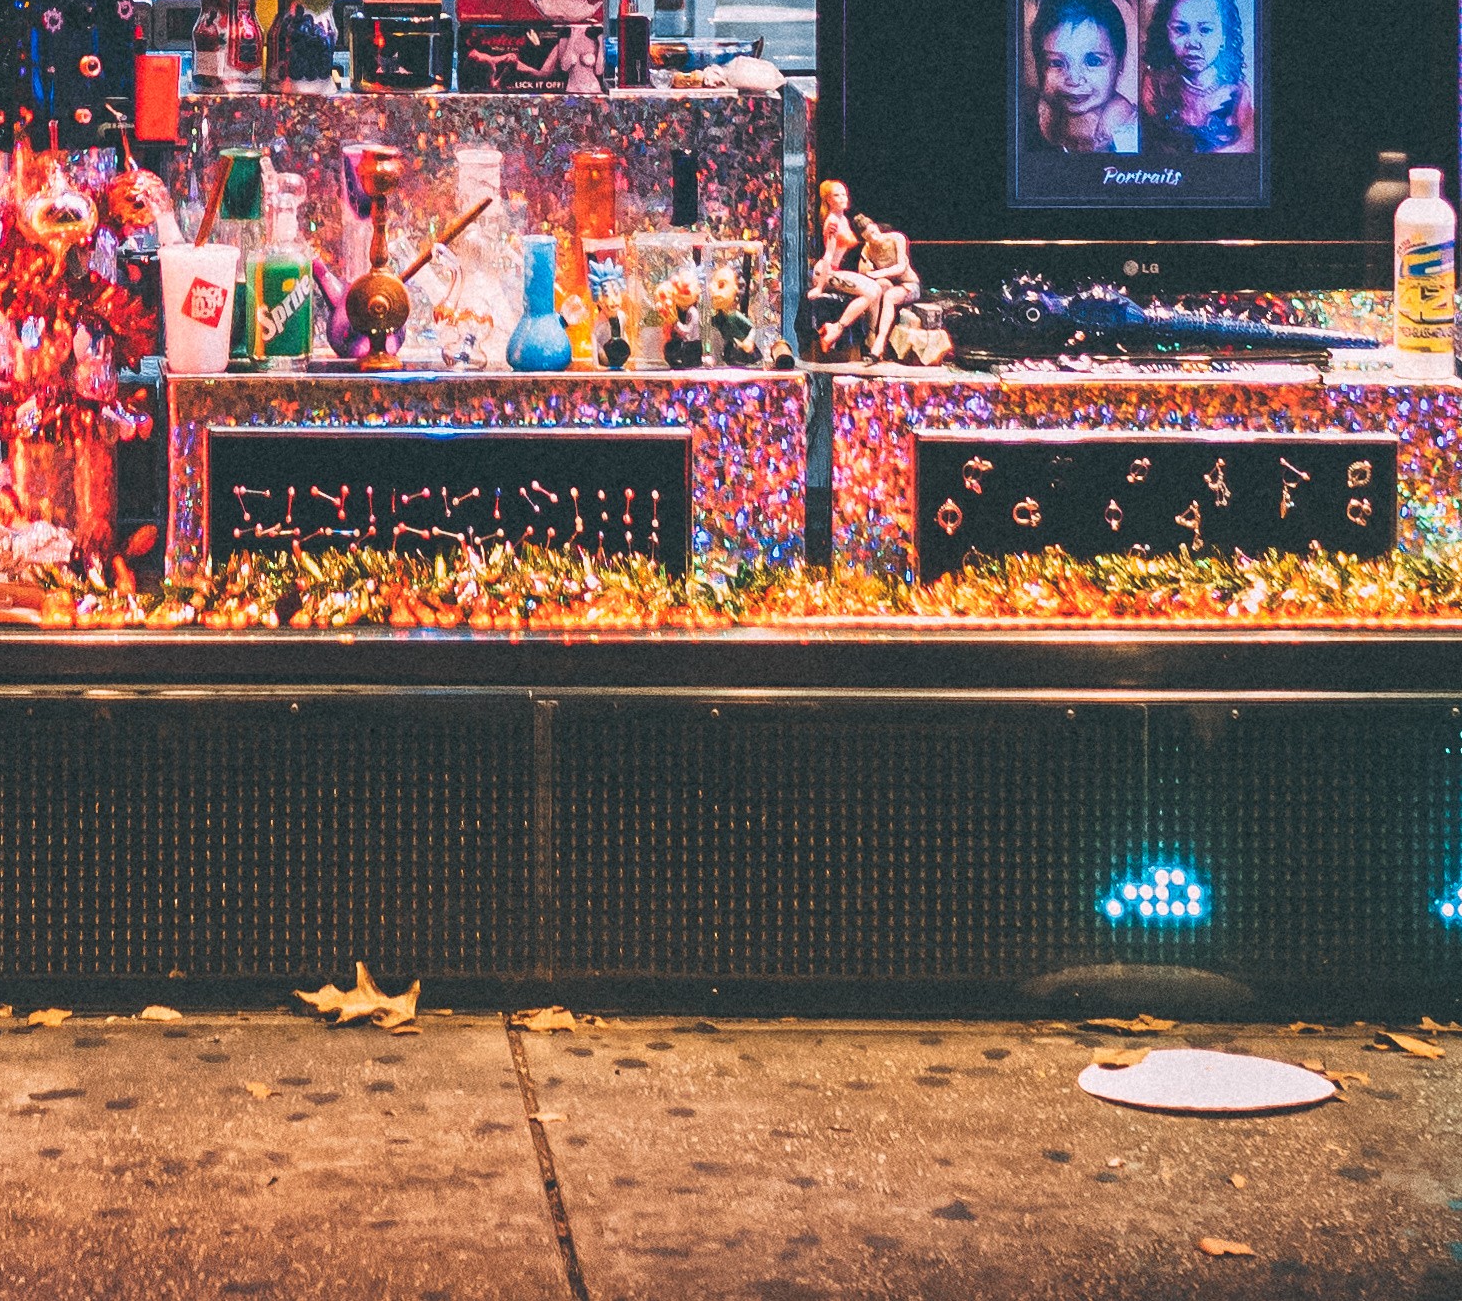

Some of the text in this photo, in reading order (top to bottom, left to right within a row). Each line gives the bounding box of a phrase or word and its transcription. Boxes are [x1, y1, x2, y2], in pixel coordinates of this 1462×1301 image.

[1102, 166, 1183, 186] Portraits
[1141, 263, 1160, 274] LG
[256, 274, 311, 342] Sprite
